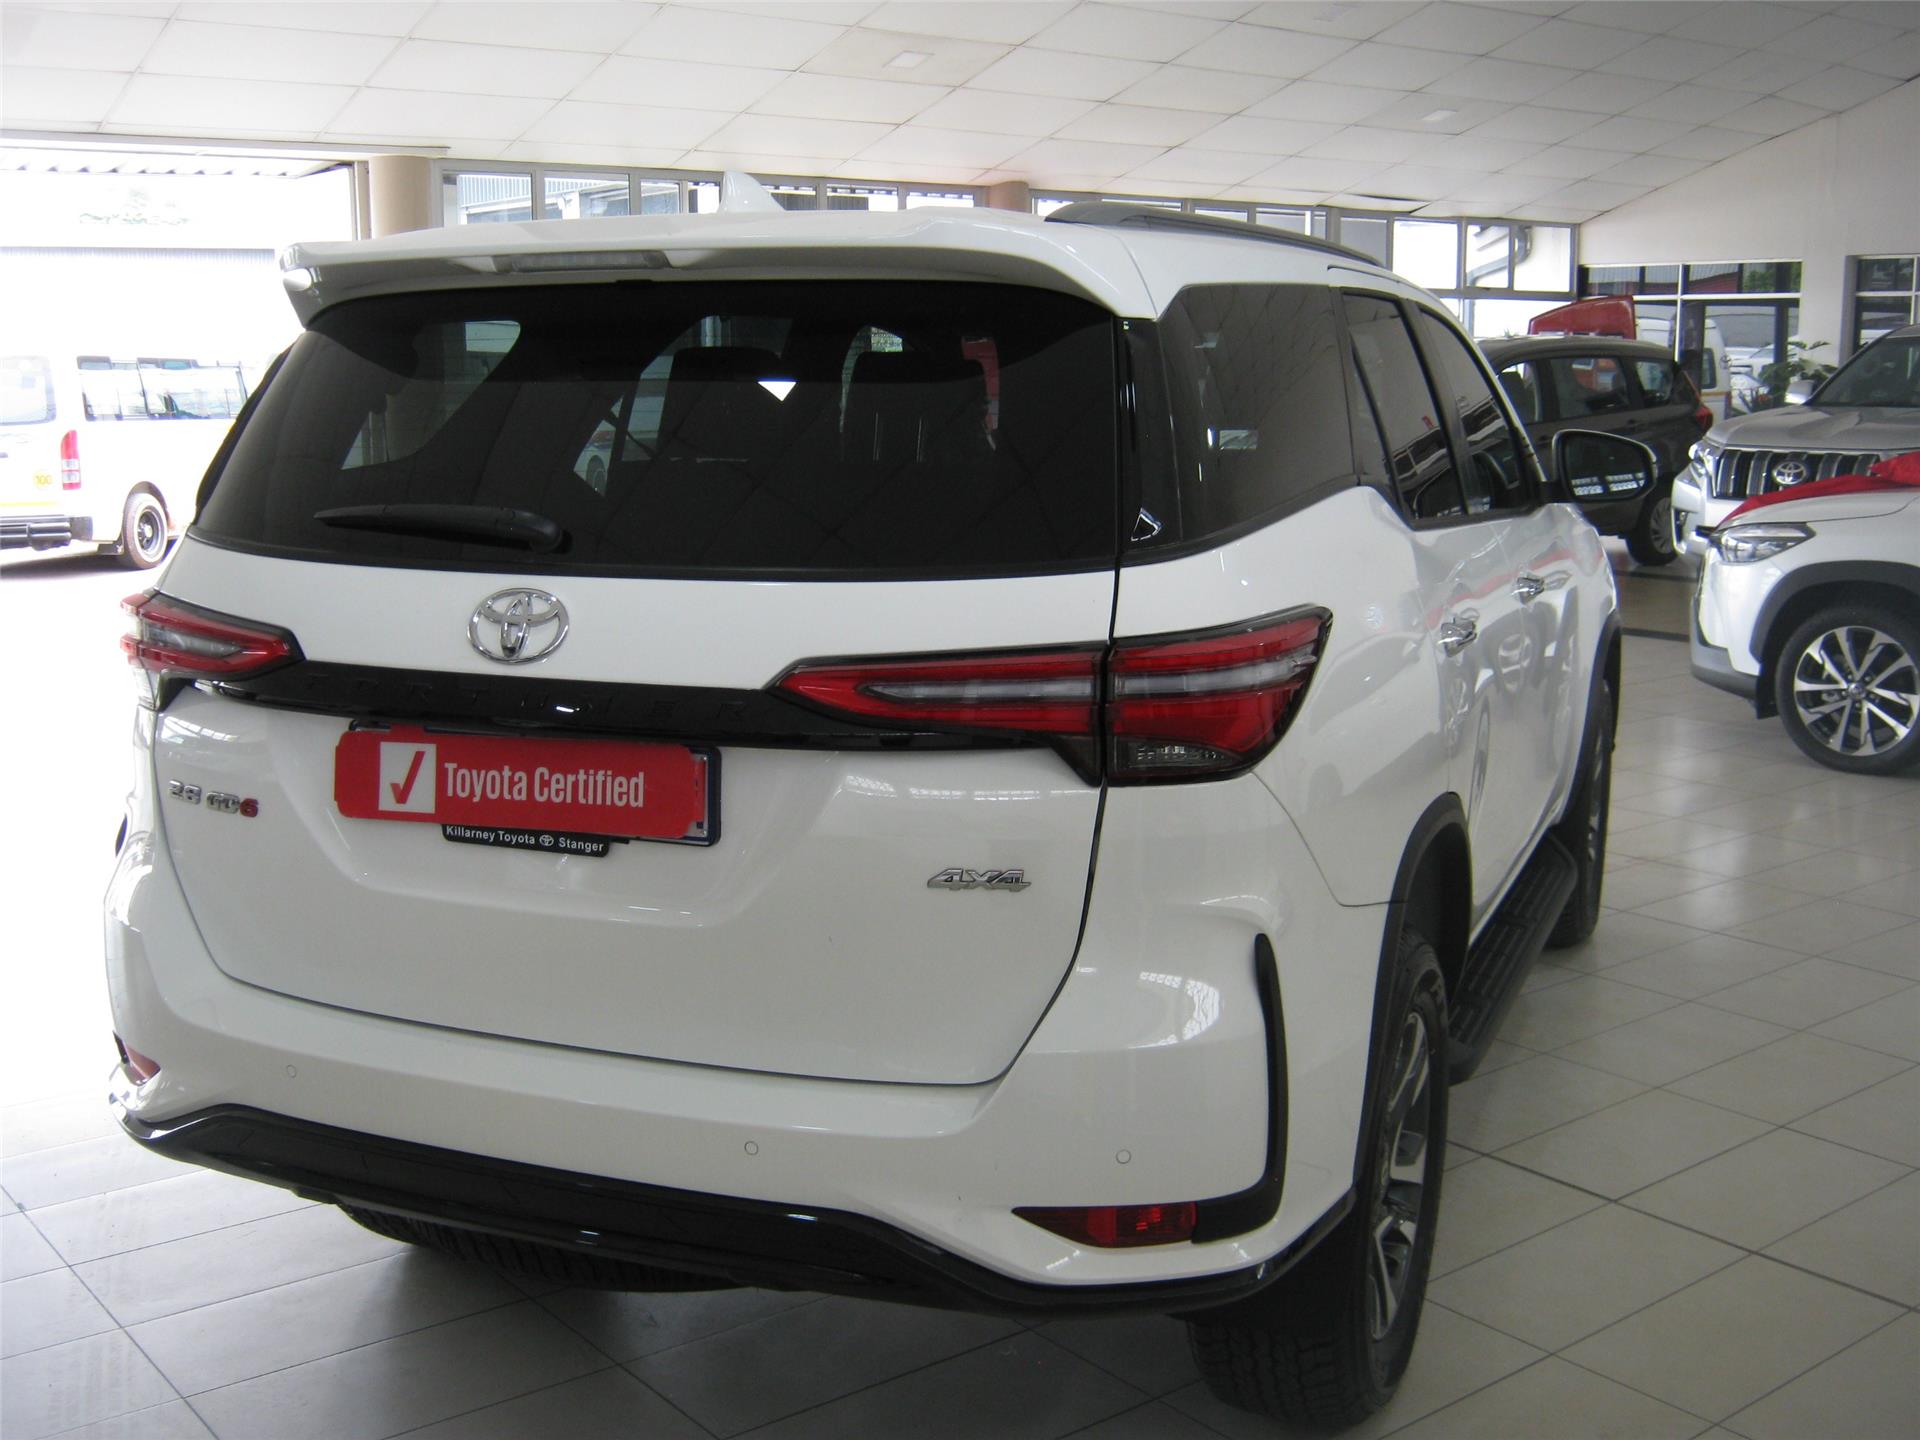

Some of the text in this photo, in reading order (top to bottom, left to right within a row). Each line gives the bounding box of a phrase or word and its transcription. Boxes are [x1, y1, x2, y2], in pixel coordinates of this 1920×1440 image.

[444, 762, 645, 809] Toyota Certified
[446, 826, 604, 853] Killarney Toyota Stanger
